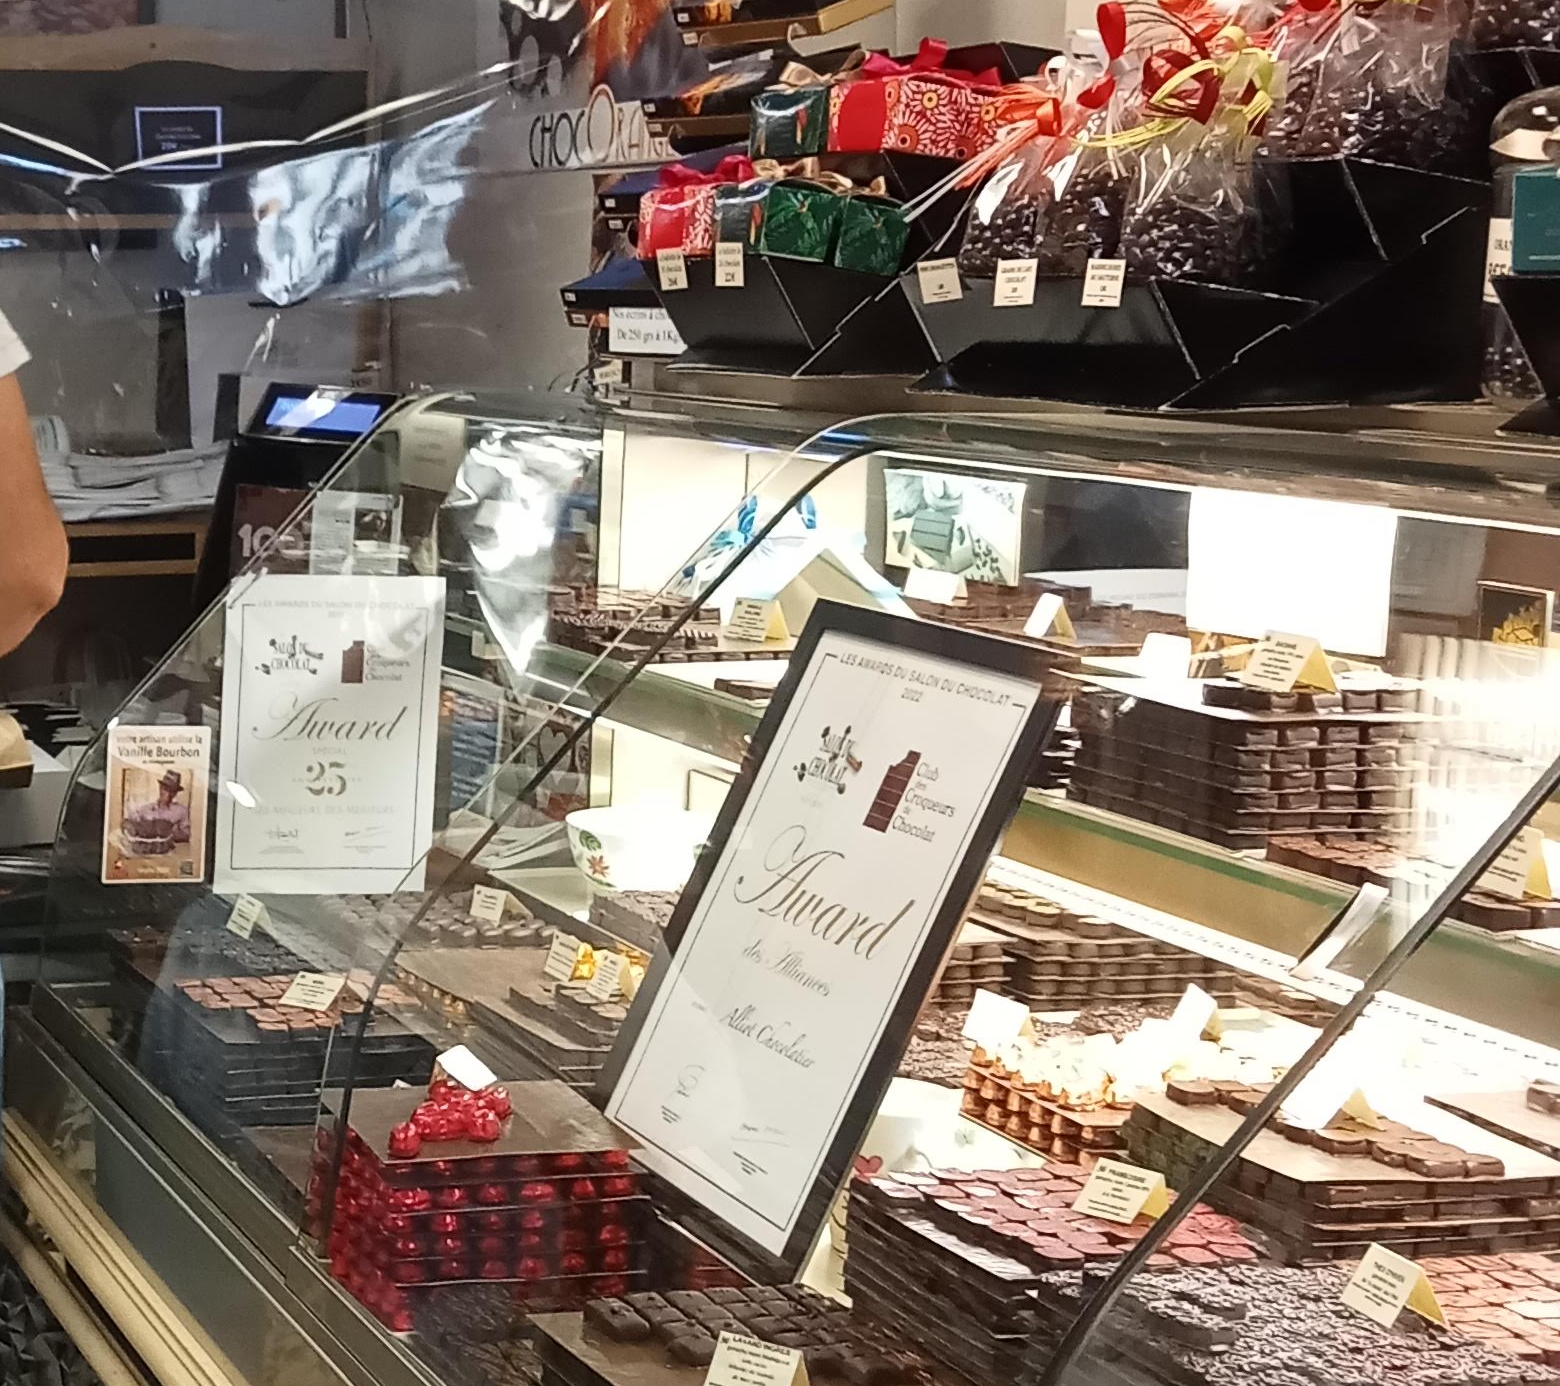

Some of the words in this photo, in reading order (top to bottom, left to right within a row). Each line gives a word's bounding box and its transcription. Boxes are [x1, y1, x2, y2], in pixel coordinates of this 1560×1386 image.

[840, 653, 857, 666] LES
[858, 658, 893, 675] AWARDS
[894, 666, 906, 679] DU
[908, 670, 940, 688] SALON
[940, 679, 954, 692] DU
[956, 683, 1010, 706] CHOCOLAT
[901, 688, 923, 703] 2022
[251, 691, 408, 742] Award
[117, 745, 153, 757] Vanille
[156, 745, 200, 757] Bourbon
[306, 761, 347, 796] 25
[916, 762, 939, 782] Club
[905, 788, 955, 817] Croqueurs
[892, 814, 936, 842] Chocolat
[734, 824, 915, 960] Award
